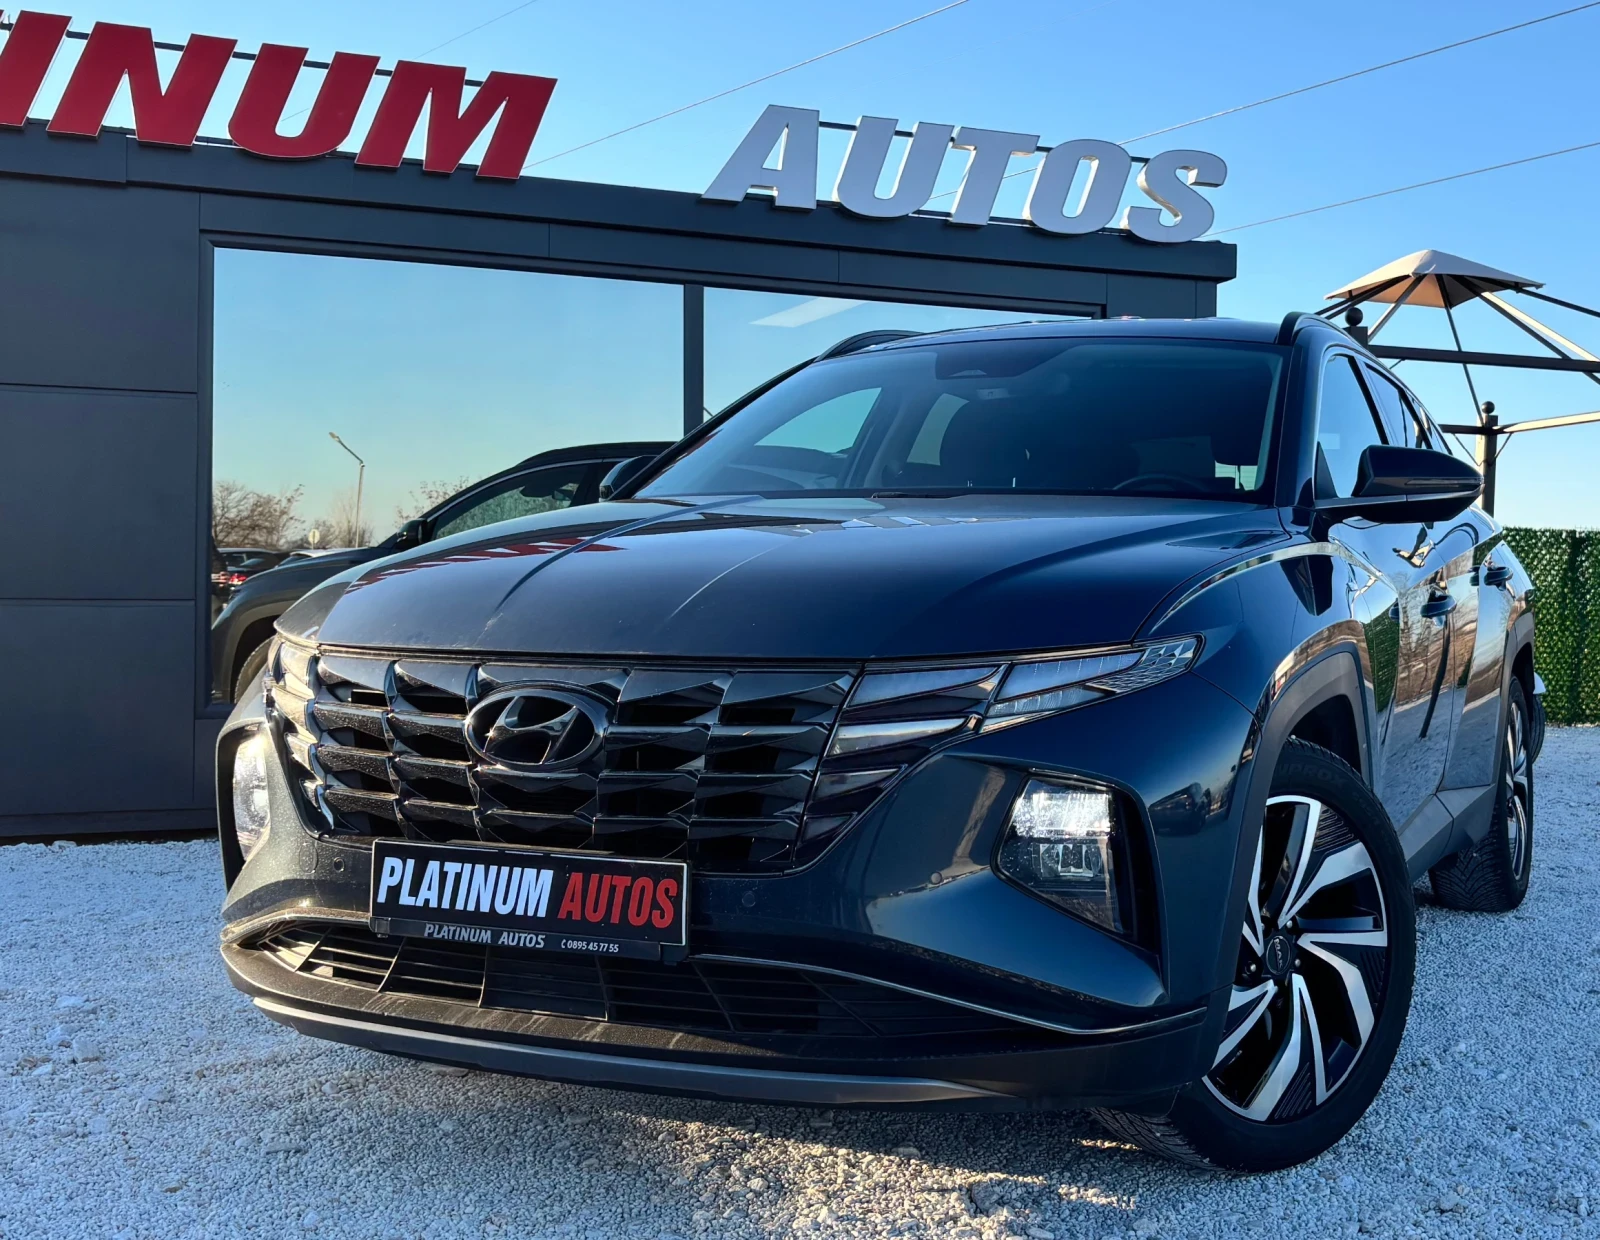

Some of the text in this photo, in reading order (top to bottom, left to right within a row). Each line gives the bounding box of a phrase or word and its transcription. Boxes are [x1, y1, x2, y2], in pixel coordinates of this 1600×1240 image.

[0, 10, 1228, 243] INUM AUTOS
[376, 856, 678, 929] PLATINUM AUTOS
[424, 923, 491, 944] PLATINUM
[498, 931, 546, 948] AUTOS
[567, 940, 588, 950] 0895
[609, 943, 619, 953] 55
